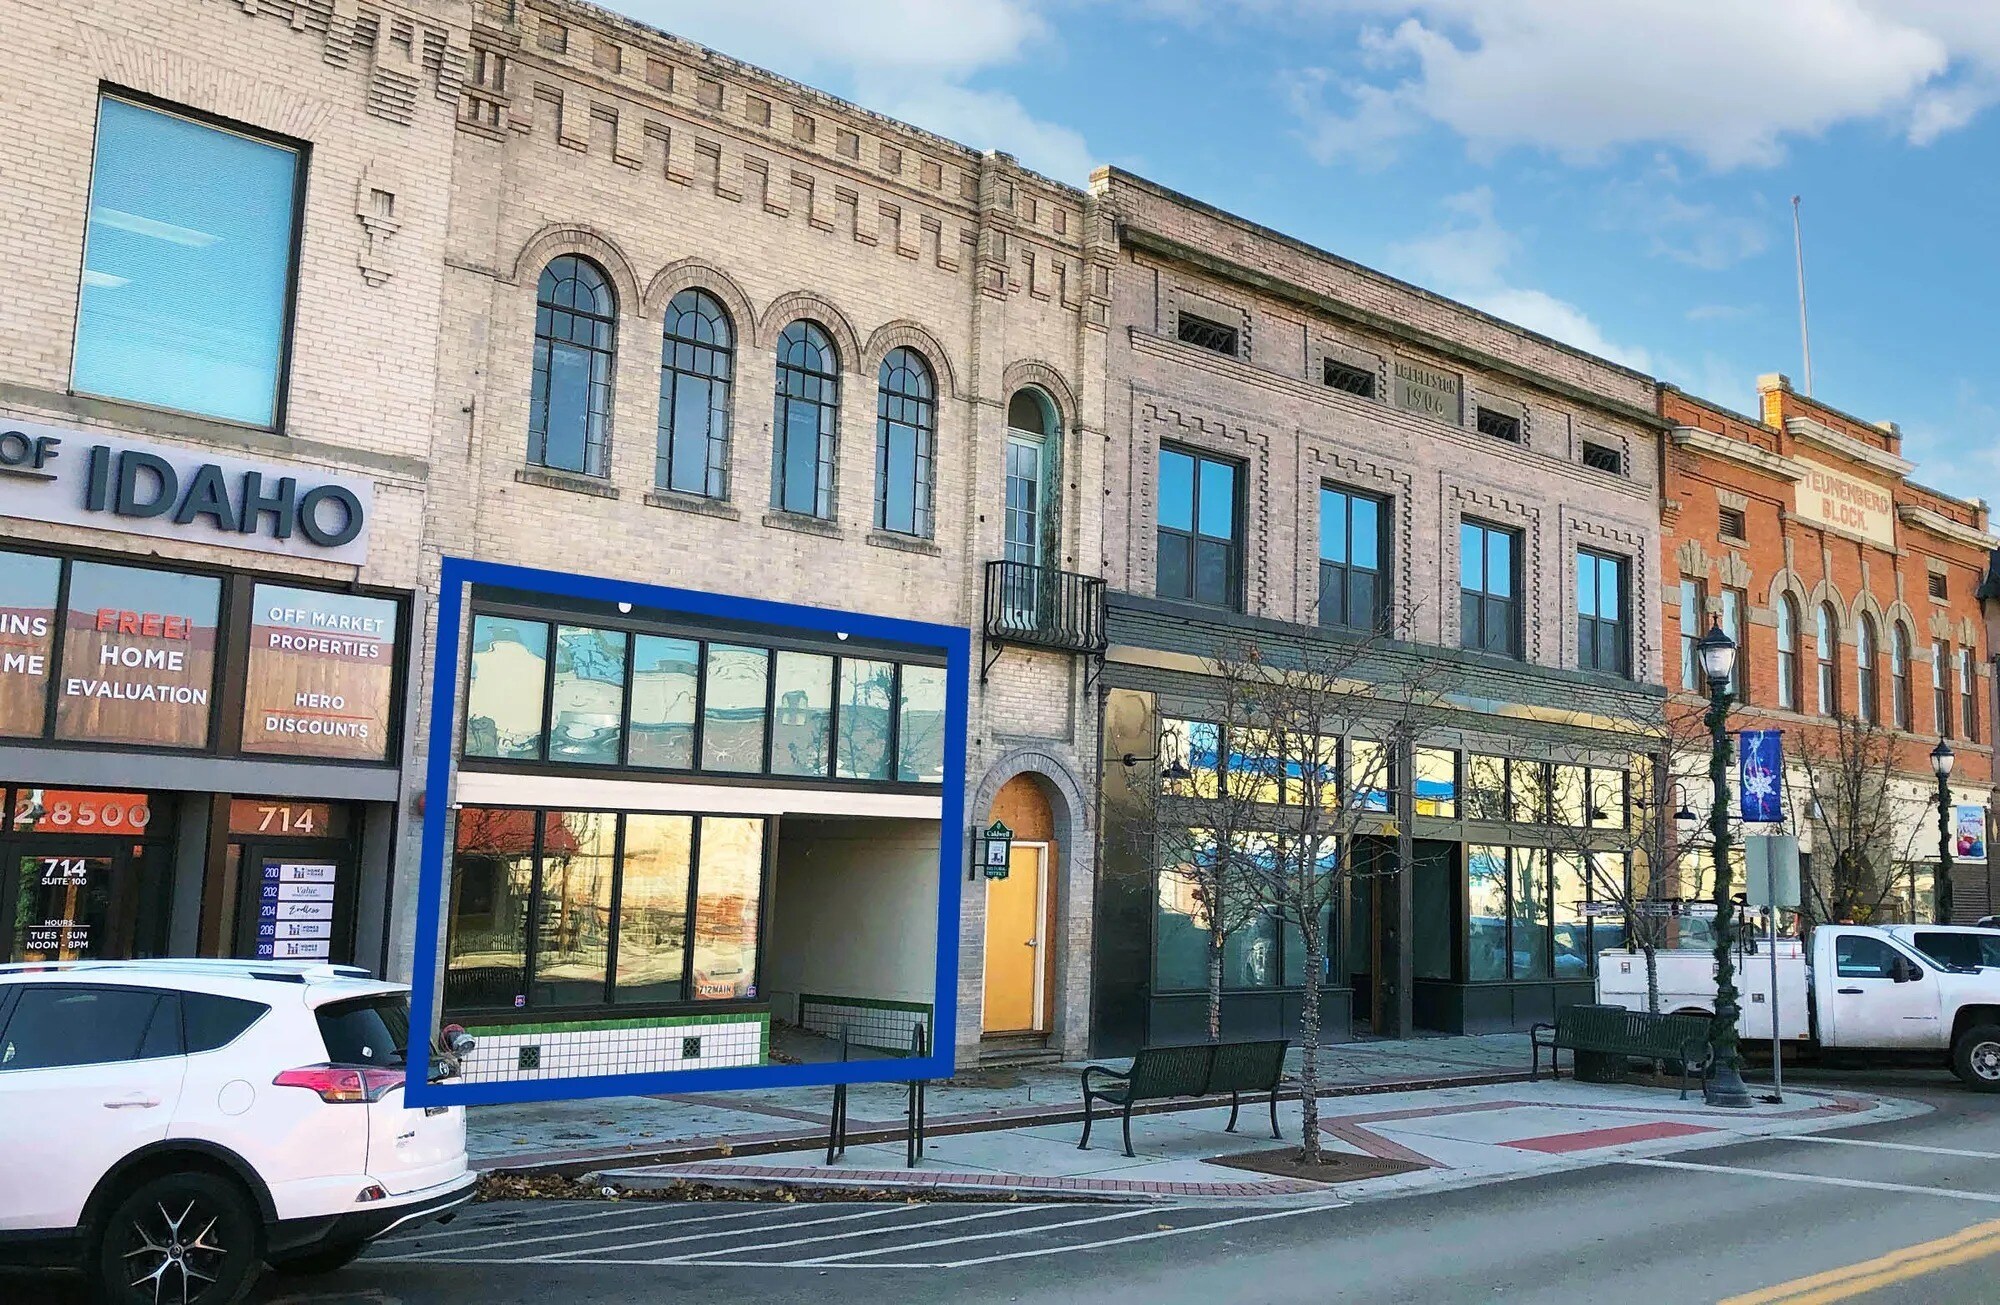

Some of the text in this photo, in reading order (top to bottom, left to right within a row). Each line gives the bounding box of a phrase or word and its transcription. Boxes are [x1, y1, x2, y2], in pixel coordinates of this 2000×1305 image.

[1406, 386, 1444, 415] 1906
[0, 431, 364, 547] OF IDAHO
[1796, 469, 1889, 516] TEUNENBERG
[97, 608, 192, 640] FREE!
[269, 607, 384, 633] OFF MARKET
[269, 633, 379, 659] PROPERTIES
[100, 645, 184, 672] HOME
[66, 678, 207, 706] EVALUATION
[295, 692, 345, 711] HERO
[265, 717, 368, 738] DISCOUNTS
[0, 799, 151, 828] 2.8500
[258, 806, 314, 833] 714
[44, 858, 86, 877] 714
[265, 867, 279, 877] 200
[71, 877, 87, 885] 100
[263, 886, 278, 897] 202
[261, 906, 276, 916] 204
[30, 932, 57, 940] TUES
[260, 925, 274, 935] 206
[26, 941, 59, 949] NOON
[258, 945, 273, 955] 208
